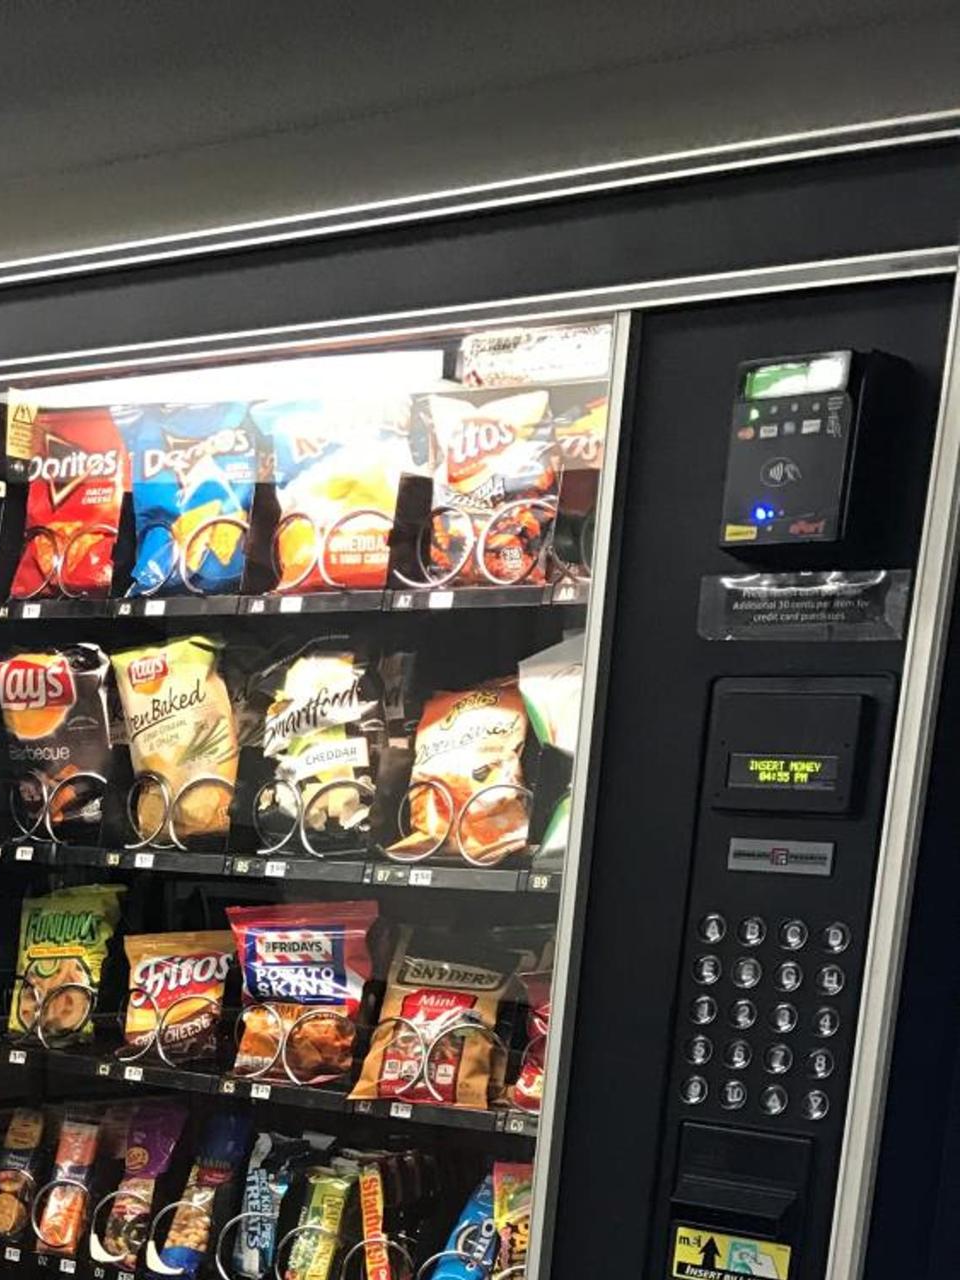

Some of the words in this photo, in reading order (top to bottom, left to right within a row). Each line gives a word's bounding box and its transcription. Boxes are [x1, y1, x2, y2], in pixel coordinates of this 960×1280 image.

[28, 449, 117, 482] Doritos
[152, 679, 206, 721] Baked
[265, 677, 363, 746] Smartfood
[305, 747, 358, 766] CHEDDAR
[749, 760, 784, 772] INSERT
[789, 760, 821, 773] MONEY
[794, 772, 809, 783] PM
[131, 953, 234, 1007] Fritos
[417, 994, 456, 1008] Mini
[164, 1013, 211, 1043] CHEESE
